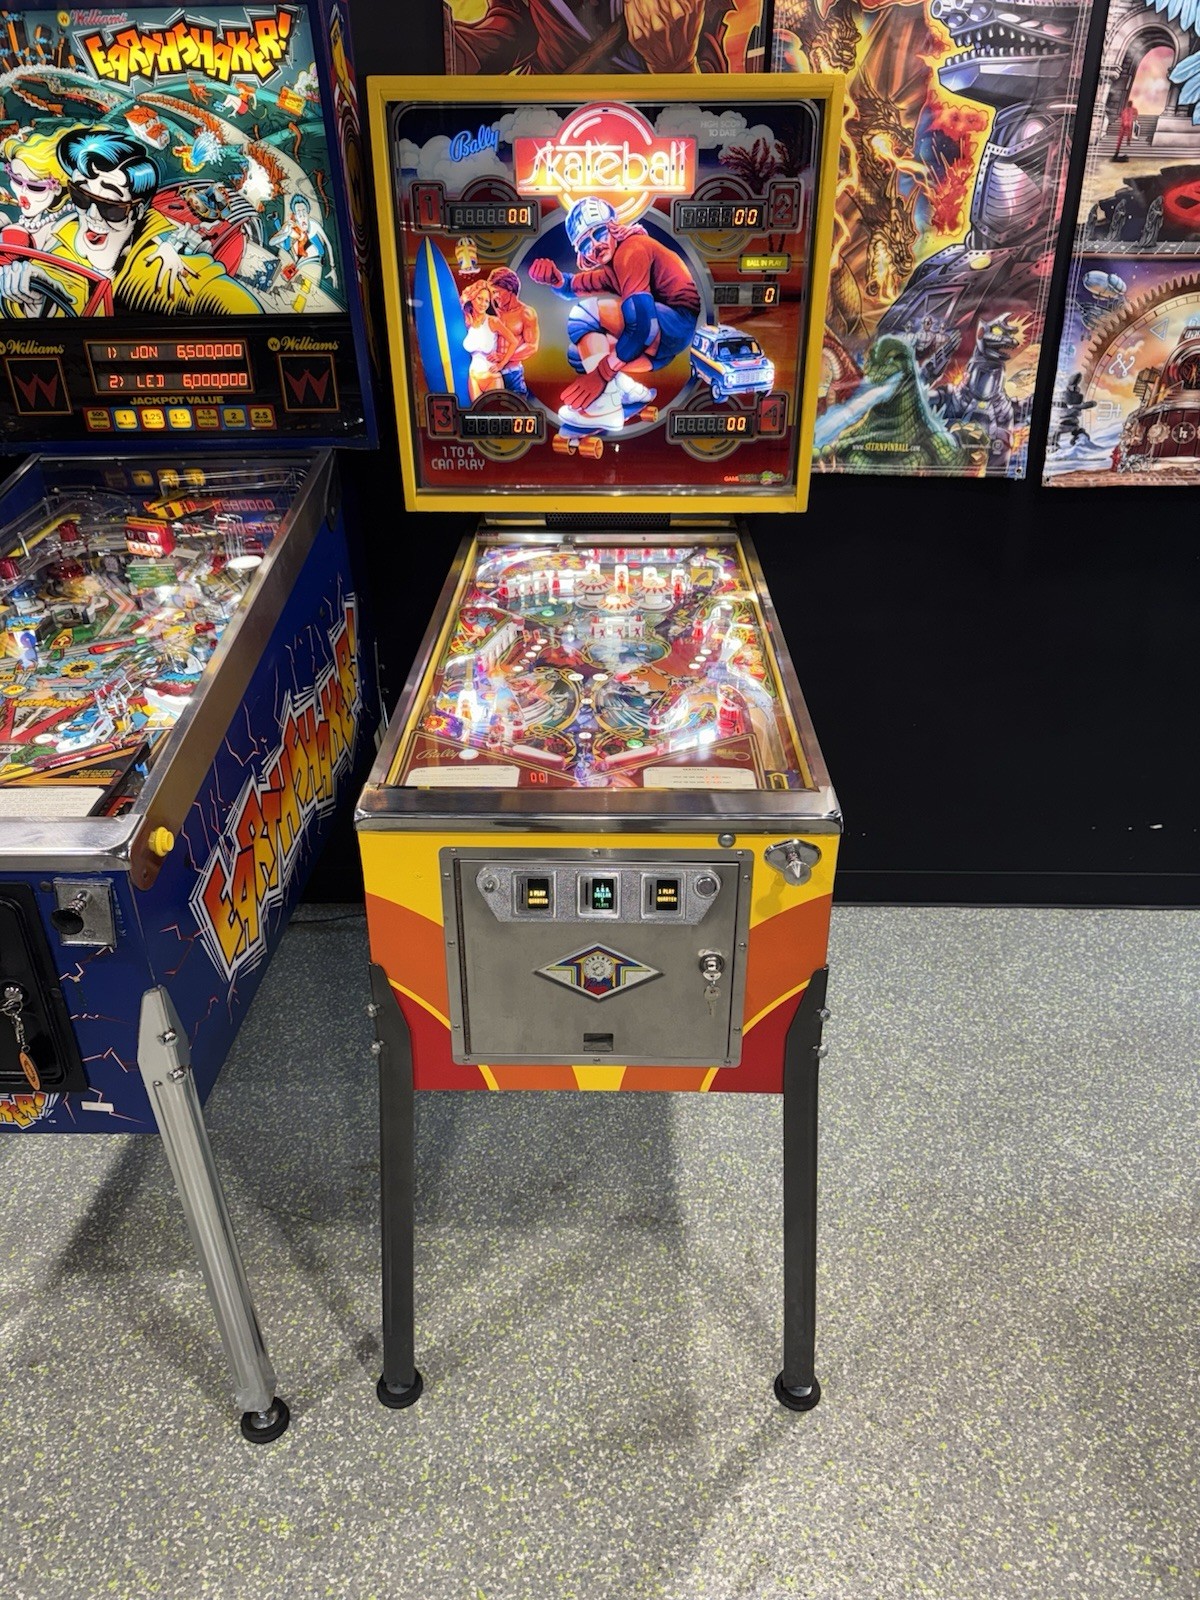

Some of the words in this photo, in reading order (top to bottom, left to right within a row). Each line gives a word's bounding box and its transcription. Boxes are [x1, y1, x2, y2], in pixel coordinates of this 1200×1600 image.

[70, 9, 128, 26] Williams
[85, 11, 292, 83] EARTHSHAKER!
[709, 129, 718, 137] TO
[719, 129, 736, 137] DATE
[449, 124, 500, 162] Bally
[774, 193, 792, 220] 2
[508, 208, 528, 224] 00
[734, 208, 758, 225] 00
[746, 259, 760, 267] BALL
[761, 259, 768, 267] IN
[768, 259, 782, 267] PLAY
[764, 287, 776, 303] 0
[7, 339, 64, 355] Williams
[281, 336, 339, 351] Williams
[108, 347, 117, 358] 1)
[130, 346, 158, 359] JON
[176, 344, 242, 360] 6,500,000
[109, 375, 124, 388] 2)
[136, 375, 165, 388] LED
[182, 373, 247, 389] 6,000,000
[130, 396, 183, 405] JACKPOT
[186, 396, 225, 404] VALUE
[254, 411, 268, 419] 2.5
[435, 405, 451, 427] 3
[764, 404, 778, 427] 4
[513, 418, 535, 433] 00
[727, 417, 746, 431] 00
[450, 447, 465, 457] TO
[467, 447, 475, 457] 4
[431, 459, 454, 470] CAN
[457, 459, 486, 470] PLAY
